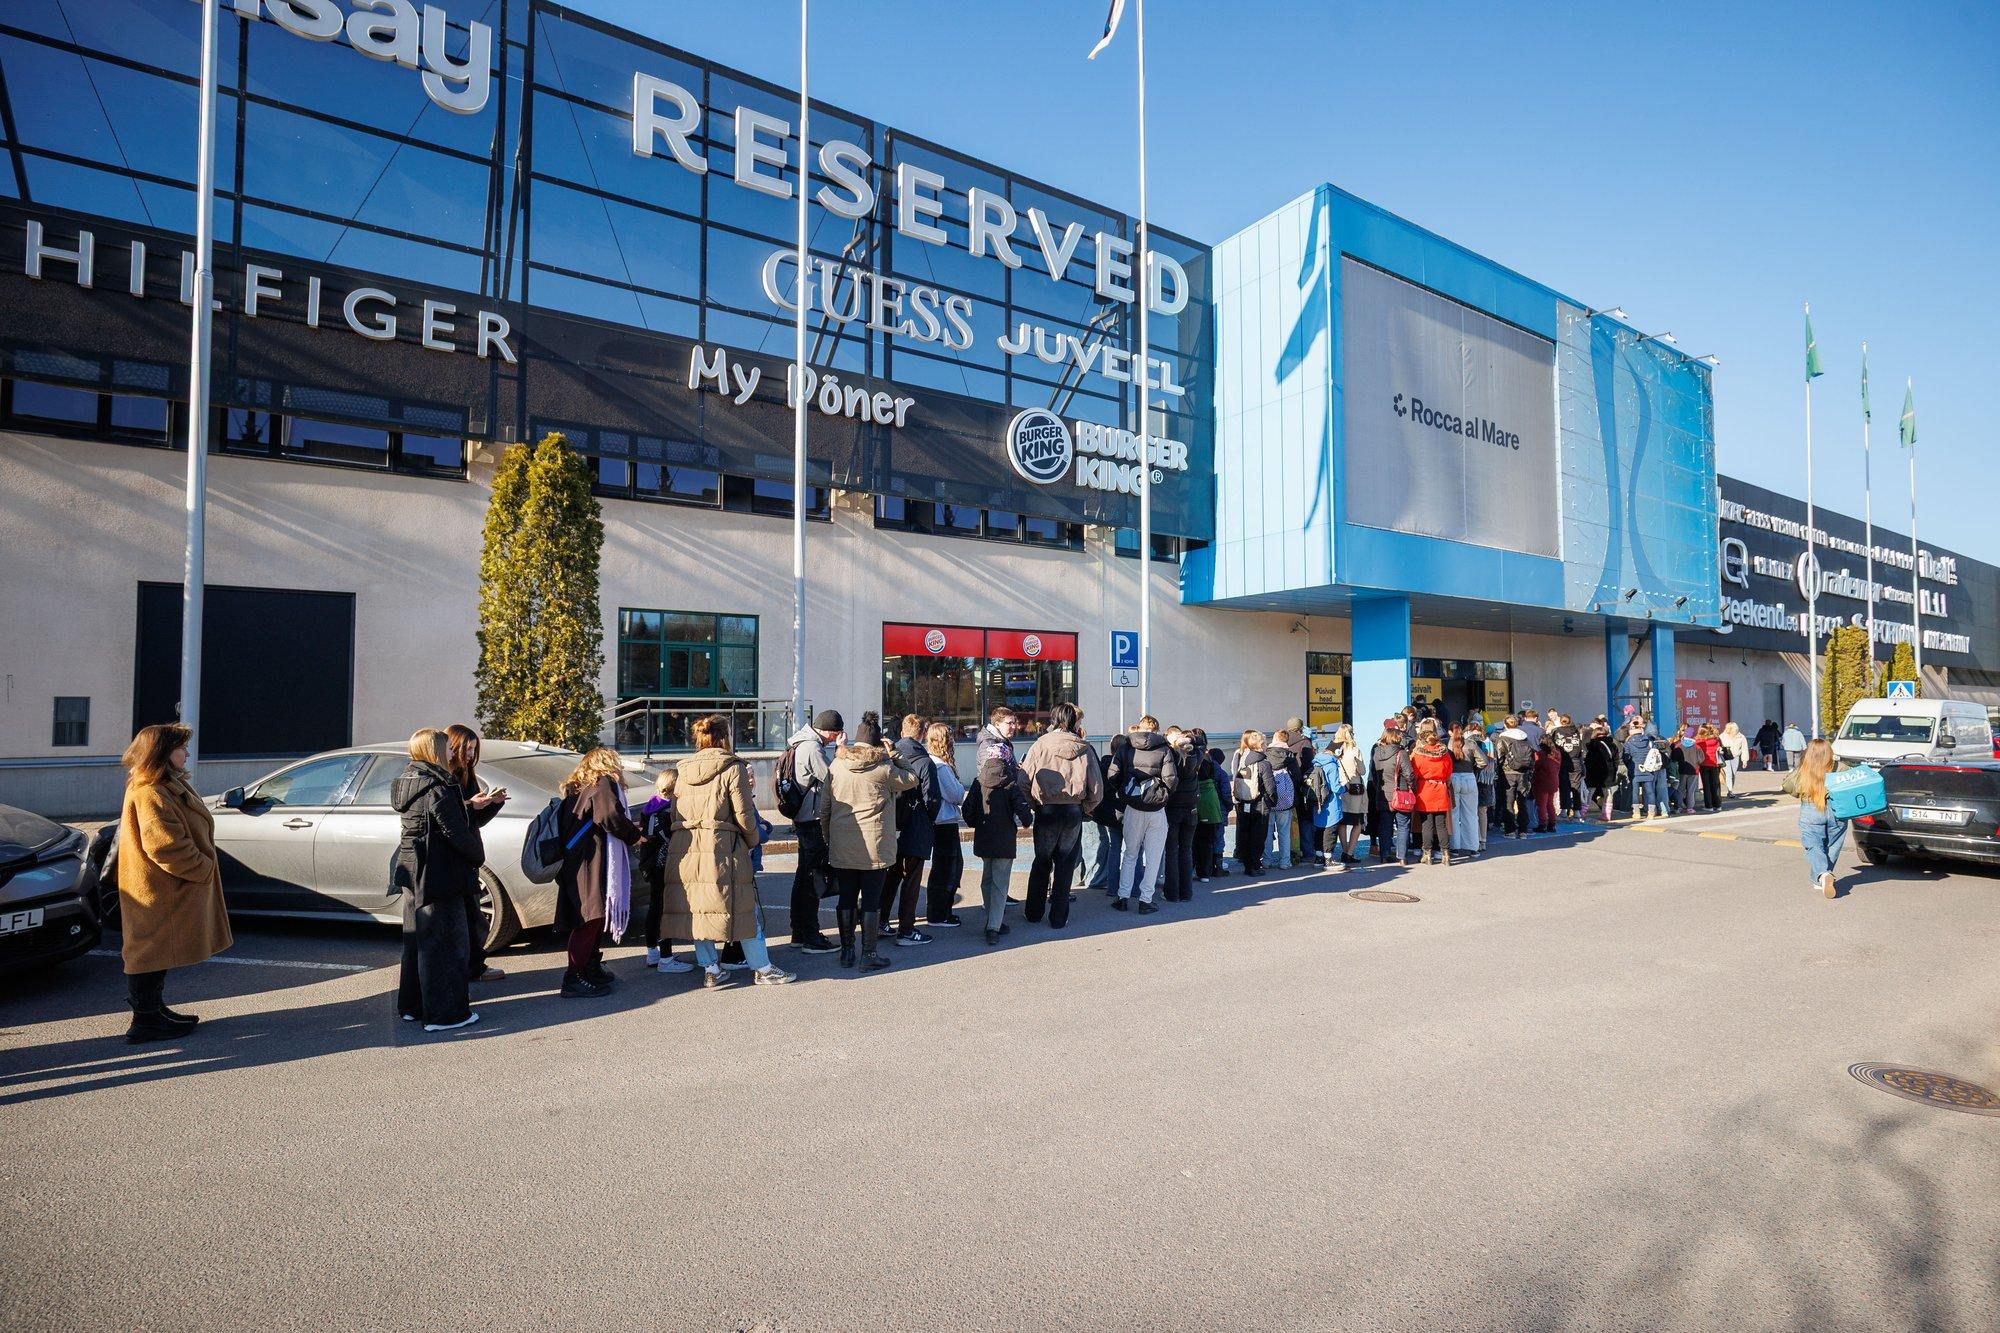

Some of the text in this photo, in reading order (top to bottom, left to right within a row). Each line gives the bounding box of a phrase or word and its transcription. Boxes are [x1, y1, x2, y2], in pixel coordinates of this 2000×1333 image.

[632, 71, 1189, 316] RESERVED
[26, 220, 517, 364] HILFIGER
[762, 248, 975, 351] GUESS
[997, 323, 1186, 396] JUVEEL
[688, 345, 915, 428] My Döner
[1019, 426, 1063, 445] BURGER
[1075, 420, 1189, 471] BURGER
[1411, 397, 1520, 451] Rocca al Mare
[1020, 438, 1065, 463] KING
[1115, 634, 1130, 664] P
[1311, 704, 1341, 712] tavahinnad
[1686, 689, 1697, 699] KFC
[1911, 810, 1958, 821] 514 TNT
